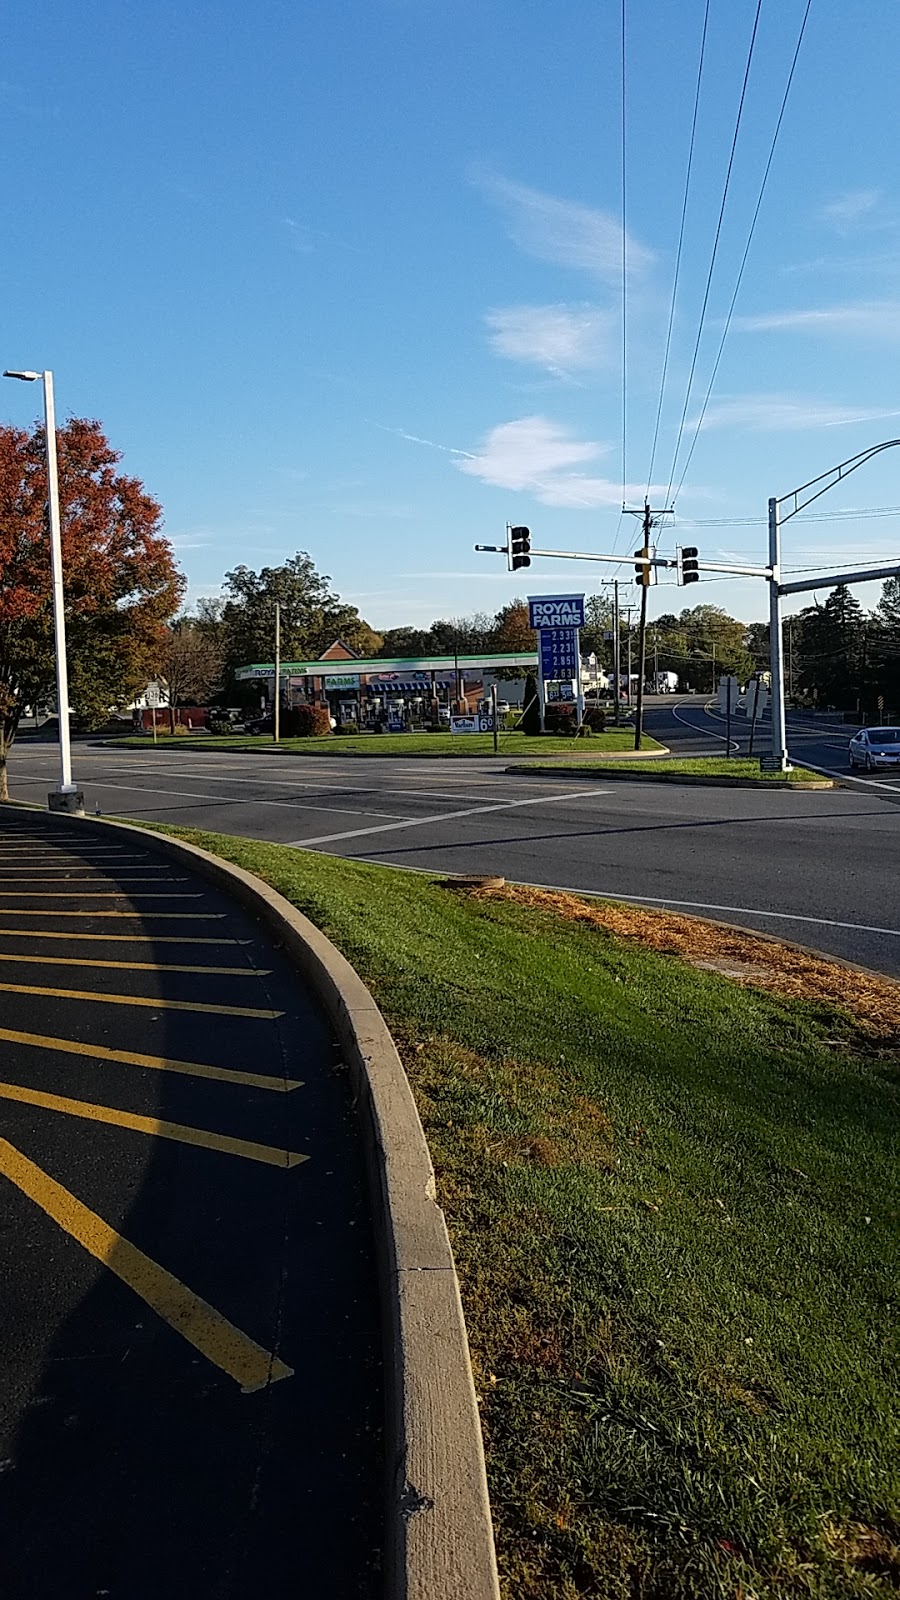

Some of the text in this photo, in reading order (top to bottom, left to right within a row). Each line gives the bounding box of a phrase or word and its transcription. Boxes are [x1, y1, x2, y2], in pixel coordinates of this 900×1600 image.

[533, 602, 581, 615] ROYAL
[533, 614, 581, 627] FARMS
[254, 669, 281, 677] ROYA
[325, 677, 356, 686] FARMS
